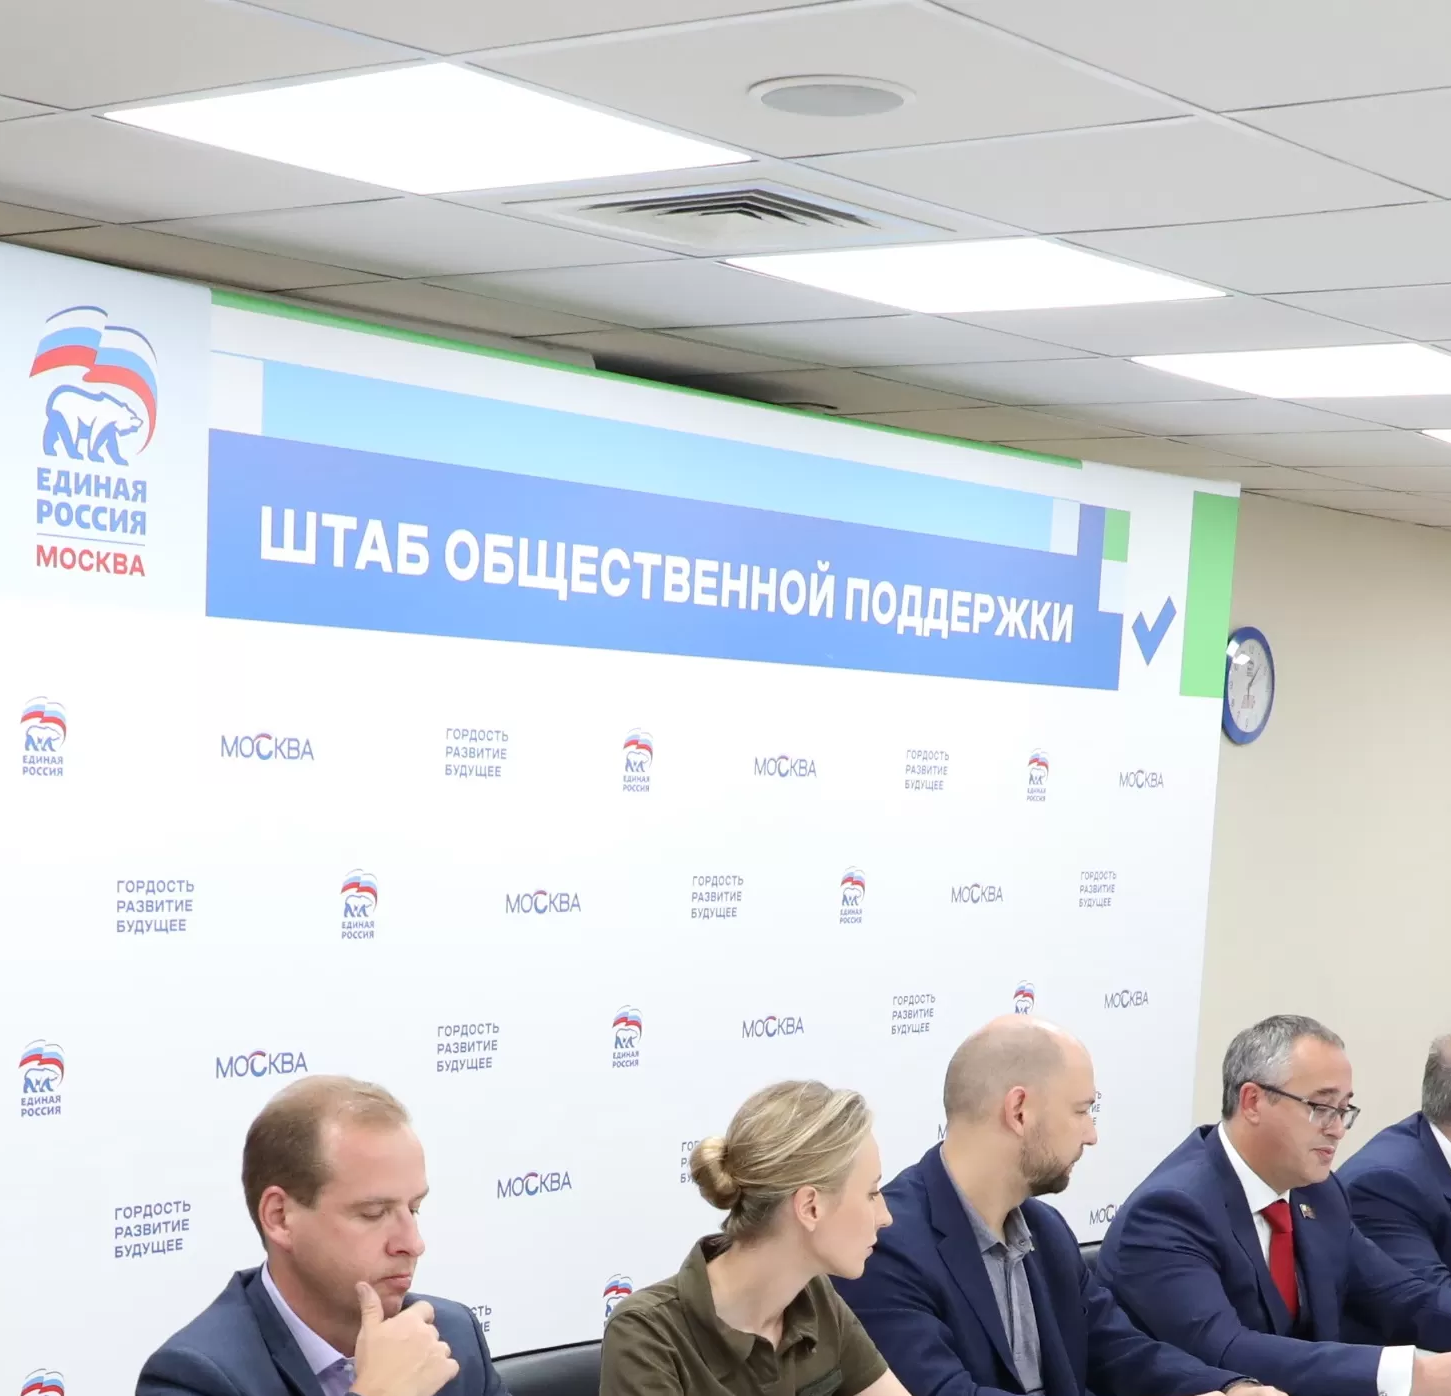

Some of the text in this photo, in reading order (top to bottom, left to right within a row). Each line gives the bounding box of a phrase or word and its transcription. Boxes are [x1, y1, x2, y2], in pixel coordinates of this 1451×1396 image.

[37, 467, 147, 503] ЕДИНАЯ
[37, 499, 146, 535] РОССИЯ
[37, 545, 145, 576] МОСКВА
[261, 506, 1073, 644] ШТАБ ОБЩЕСТВЕННОЙ ПОДДЕРЖКИ
[446, 728, 508, 743] ГОРДОСТЬ
[221, 733, 314, 760] МОСКВА
[446, 746, 507, 759] РАЗВИТИЕ
[22, 754, 64, 765] ЕДИНАЯ
[907, 750, 949, 764] ГОРДОСТЬ
[22, 765, 64, 777] РОССИЯ
[445, 764, 501, 779] БУДУЩЕЕ
[754, 755, 817, 778] МОСКВА
[906, 764, 948, 775] РАЗВИТИЕ
[623, 775, 650, 784] ЕДИНАЯ
[905, 780, 943, 792] БУДУЩЕЕ
[1119, 769, 1163, 789] МОСКВА
[623, 783, 650, 793] РОССИЯ
[693, 875, 744, 888] ГОРДОСТЬ
[1081, 871, 1117, 882] ГОРДОСТЬ
[117, 880, 194, 895] ГОРДОСТЬ
[951, 883, 1003, 904] МОСКВА
[1080, 884, 1115, 894] РАЗВИТИЕ
[506, 890, 581, 914] МОСКВА
[692, 891, 741, 902] РАЗВИТИЕ
[1079, 898, 1111, 908] БУДУЩЕЕ
[117, 900, 193, 912] РАЗВИТИЕ
[691, 907, 737, 920] БУДУЩЕЕ
[117, 919, 186, 935] БУДУЩЕЕ
[341, 920, 374, 930] ЕДИНАЯ
[341, 929, 374, 940] РОССИЯ
[893, 994, 936, 1008] ГОРДОСТЬ
[1105, 990, 1148, 1008] МОСКВА
[892, 1006, 934, 1022] РАЗВИТИЕ
[438, 1023, 499, 1037] ГОРДОСТЬ
[742, 1016, 804, 1038] МОСКВА
[892, 1022, 930, 1035] БУДУЩЕЕ
[437, 1040, 497, 1054] РАЗВИТИЕ
[612, 1052, 640, 1060] ЕДИНАЯ
[215, 1049, 309, 1080] МОСКВА
[437, 1057, 492, 1072] БУДУЩЕЕ
[612, 1059, 640, 1069] РОССИЯ
[20, 1095, 62, 1106] ЕДИНАЯ
[21, 1106, 62, 1117] РОССИЯ
[497, 1172, 572, 1199] МОСКВА
[115, 1201, 191, 1221] ГОРДОСТЬ
[115, 1218, 189, 1240] РАЗВИТИЕ
[115, 1238, 183, 1258] БУДУЩЕЕ
